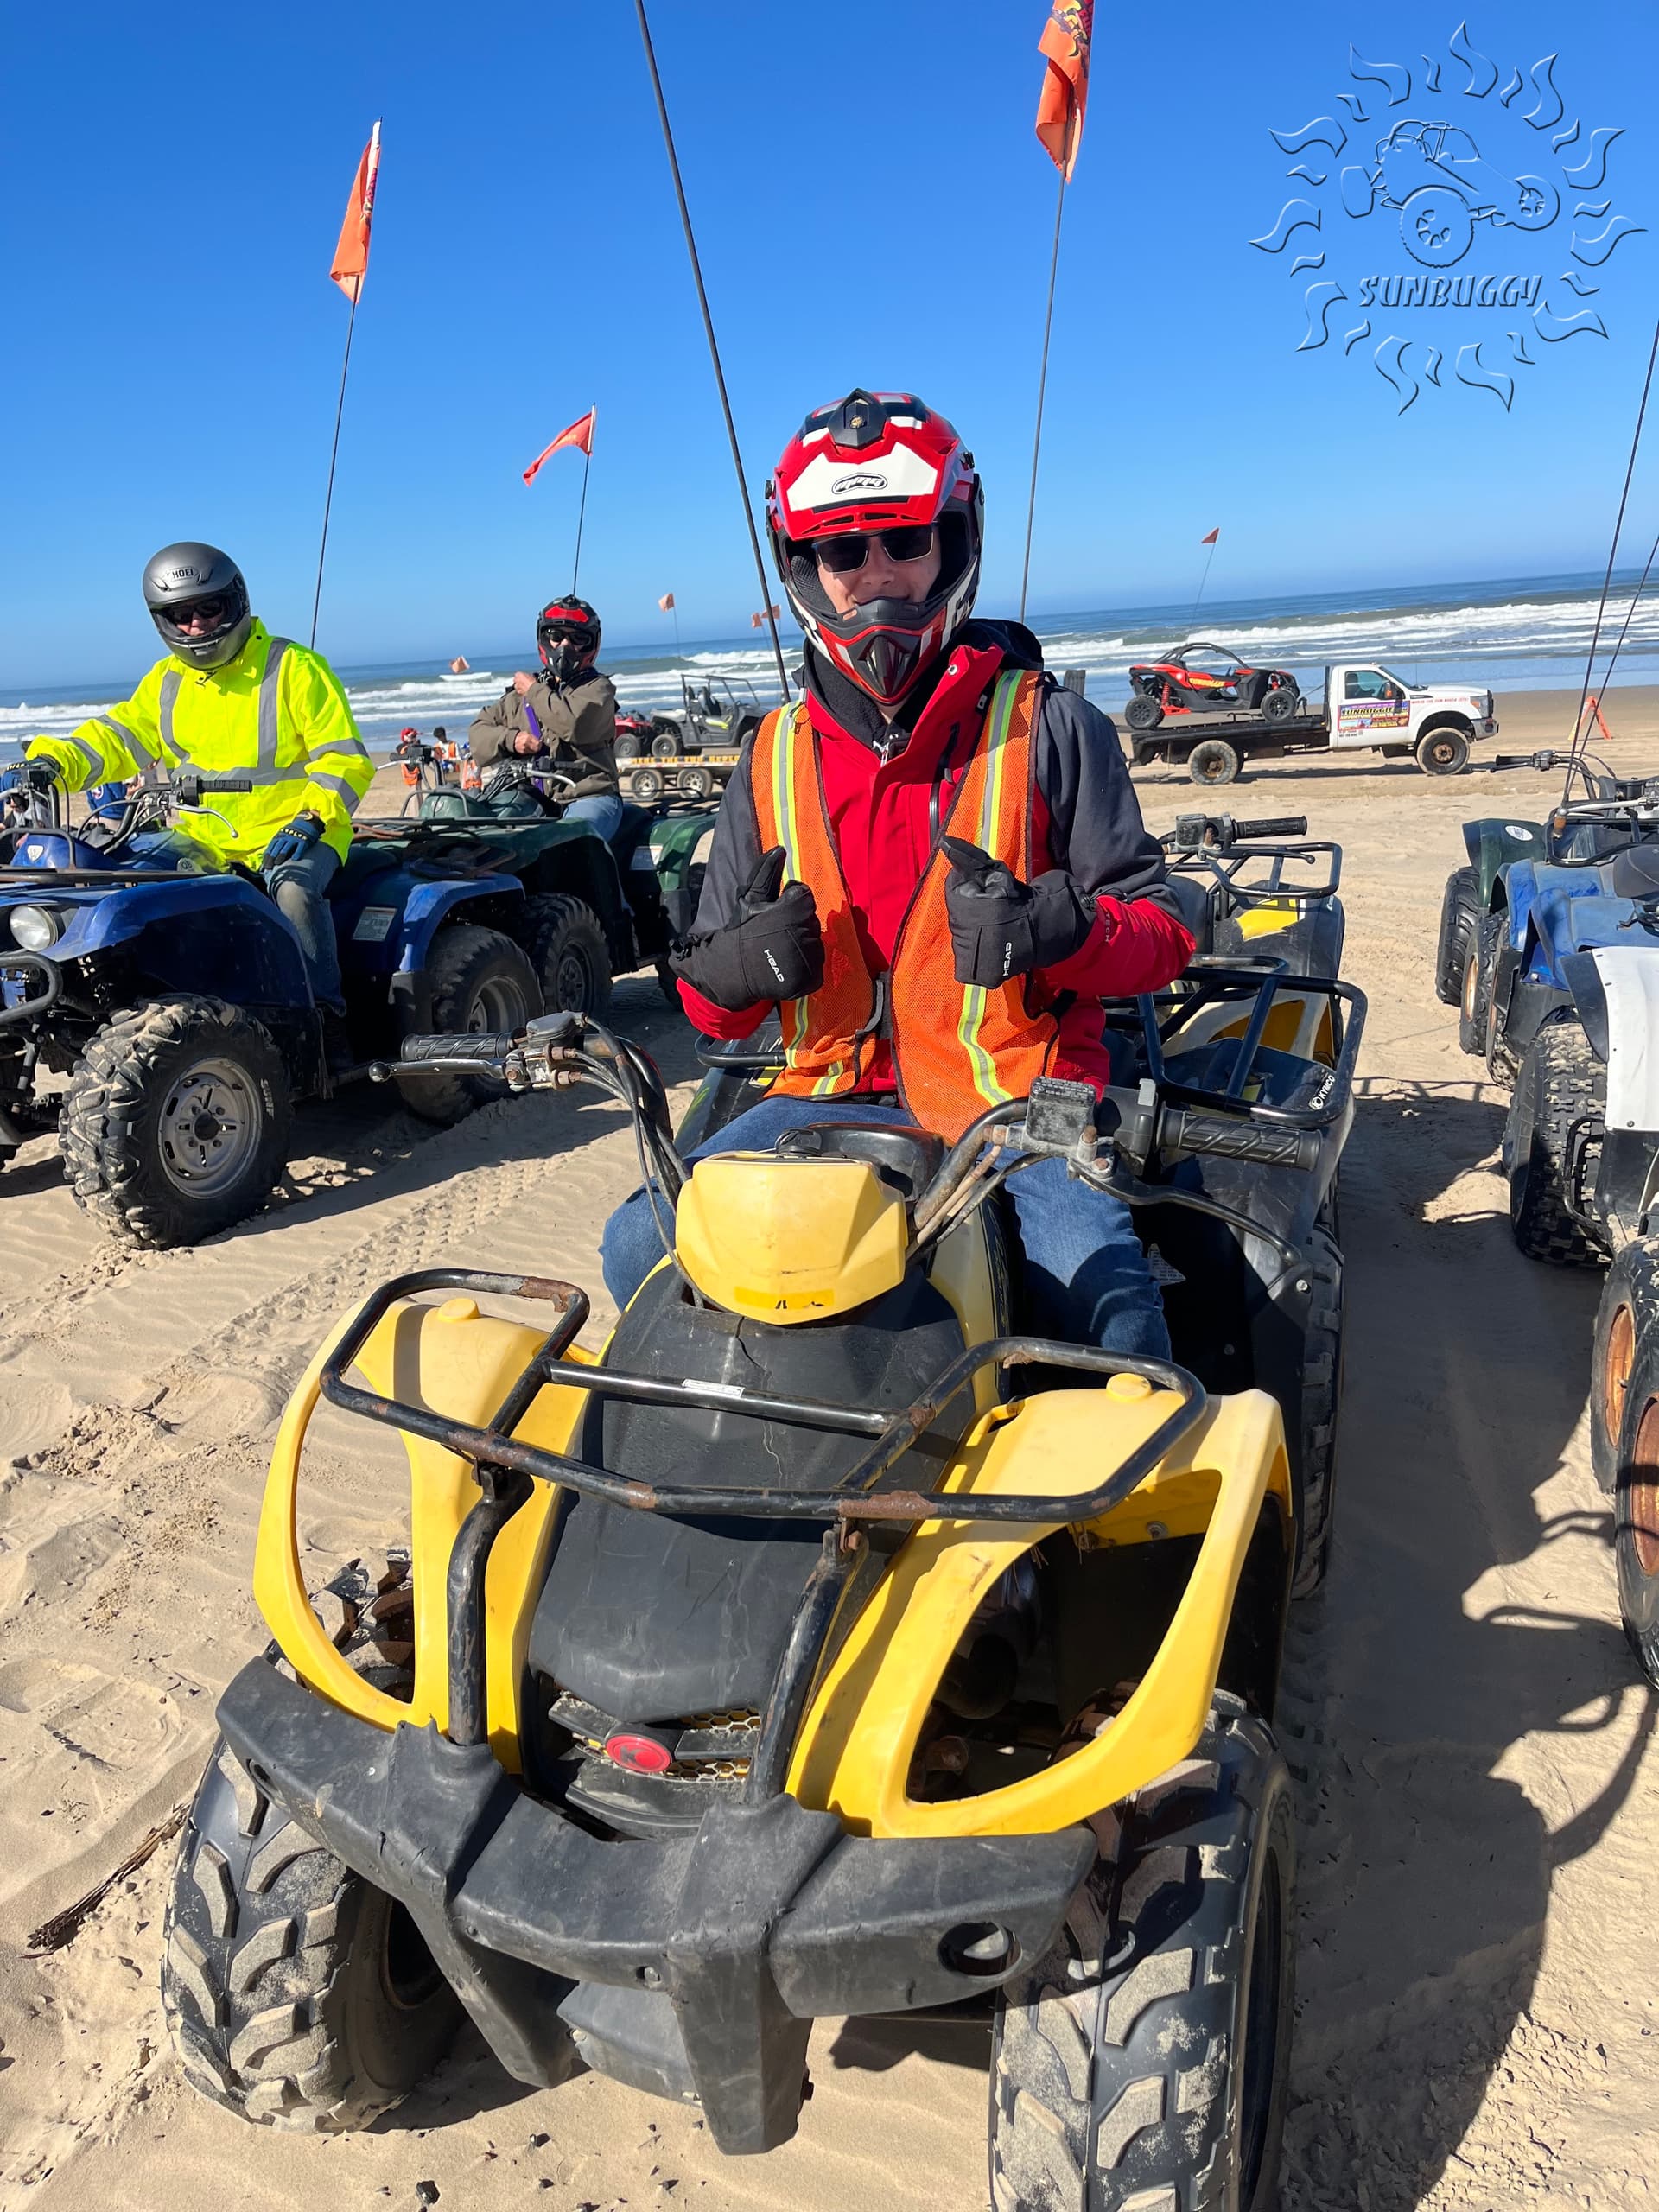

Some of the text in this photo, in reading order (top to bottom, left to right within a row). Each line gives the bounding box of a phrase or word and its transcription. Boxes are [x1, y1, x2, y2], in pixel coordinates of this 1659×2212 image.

[165, 569, 194, 578] HOEI
[764, 949, 785, 982] HEAD
[1002, 942, 1012, 976] HEAD
[1319, 1075, 1335, 1099] KYMCO
